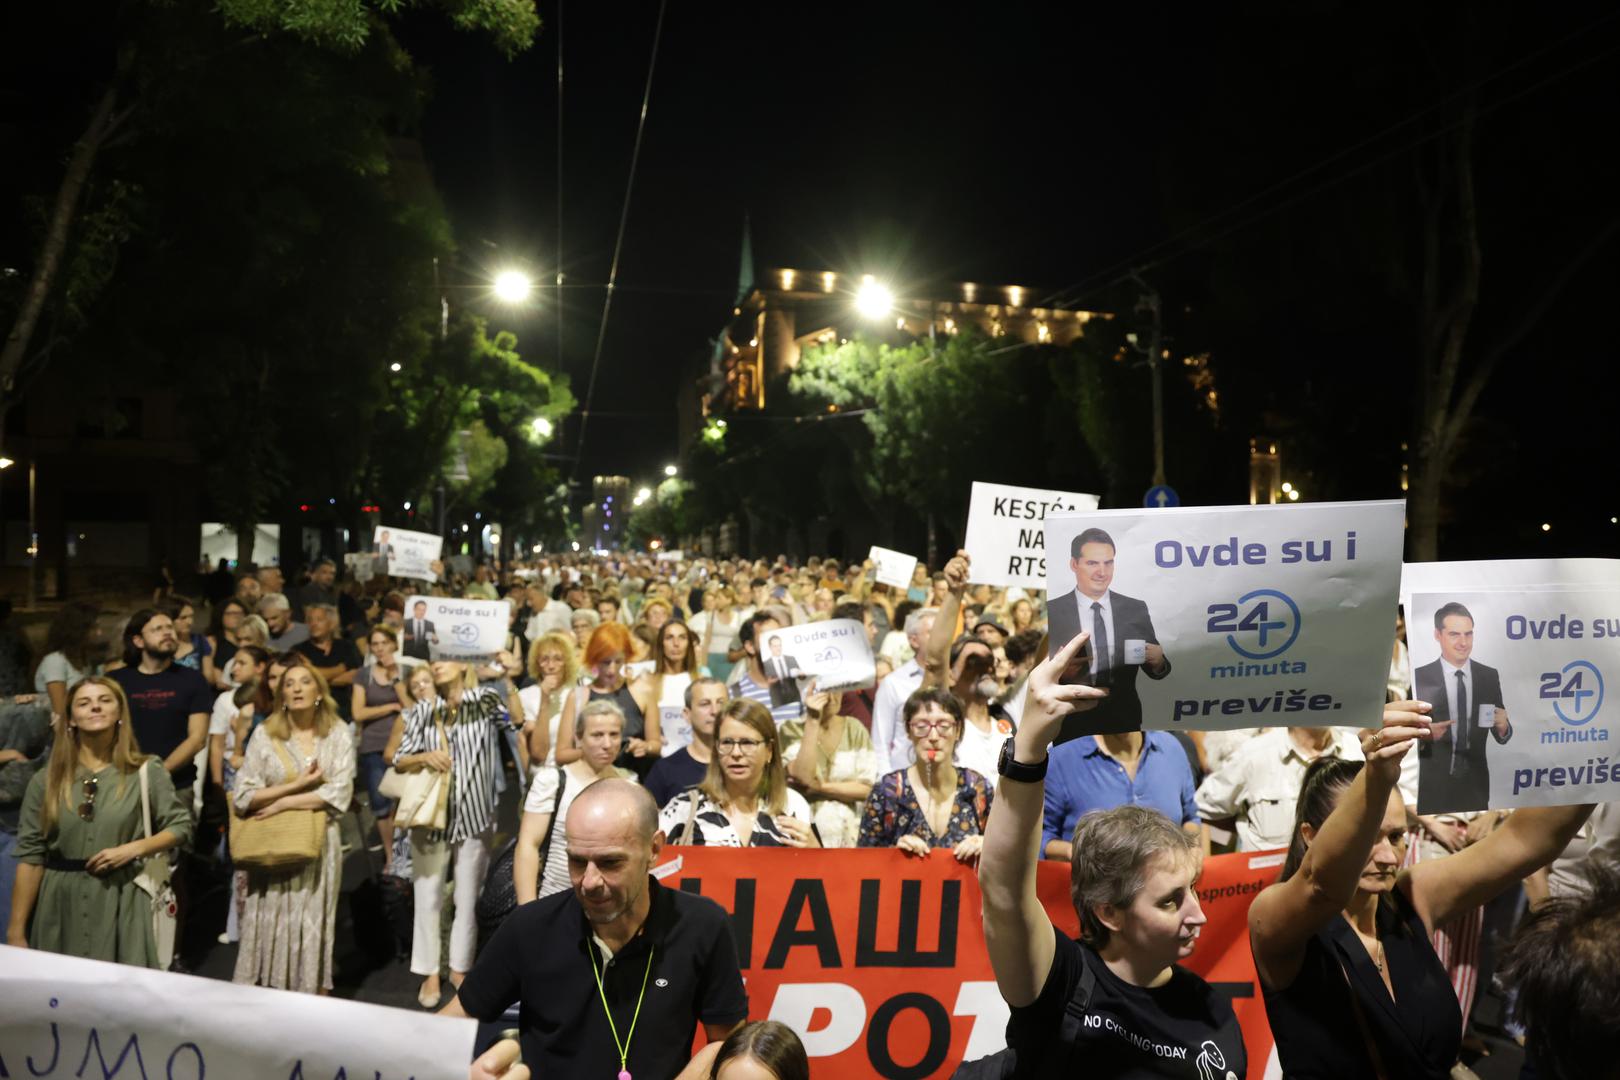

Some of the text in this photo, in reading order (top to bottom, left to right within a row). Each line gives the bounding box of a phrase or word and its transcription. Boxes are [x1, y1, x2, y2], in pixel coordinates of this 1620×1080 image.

[994, 497, 1075, 520] KESIĆ
[1154, 531, 1356, 568] Ovde su i
[438, 606, 471, 616] Ovde
[1207, 601, 1270, 634] 24
[794, 631, 827, 644] Ovde
[832, 629, 848, 637] su
[1506, 614, 1620, 640] Ovde su
[1210, 660, 1306, 678] minuta
[1539, 671, 1583, 700] 24
[1173, 688, 1342, 721] previše.
[1541, 727, 1609, 744] minuta
[681, 878, 961, 969] НАШ
[1084, 1015, 1101, 1028] NO
[1105, 1018, 1151, 1051] CYCLING
